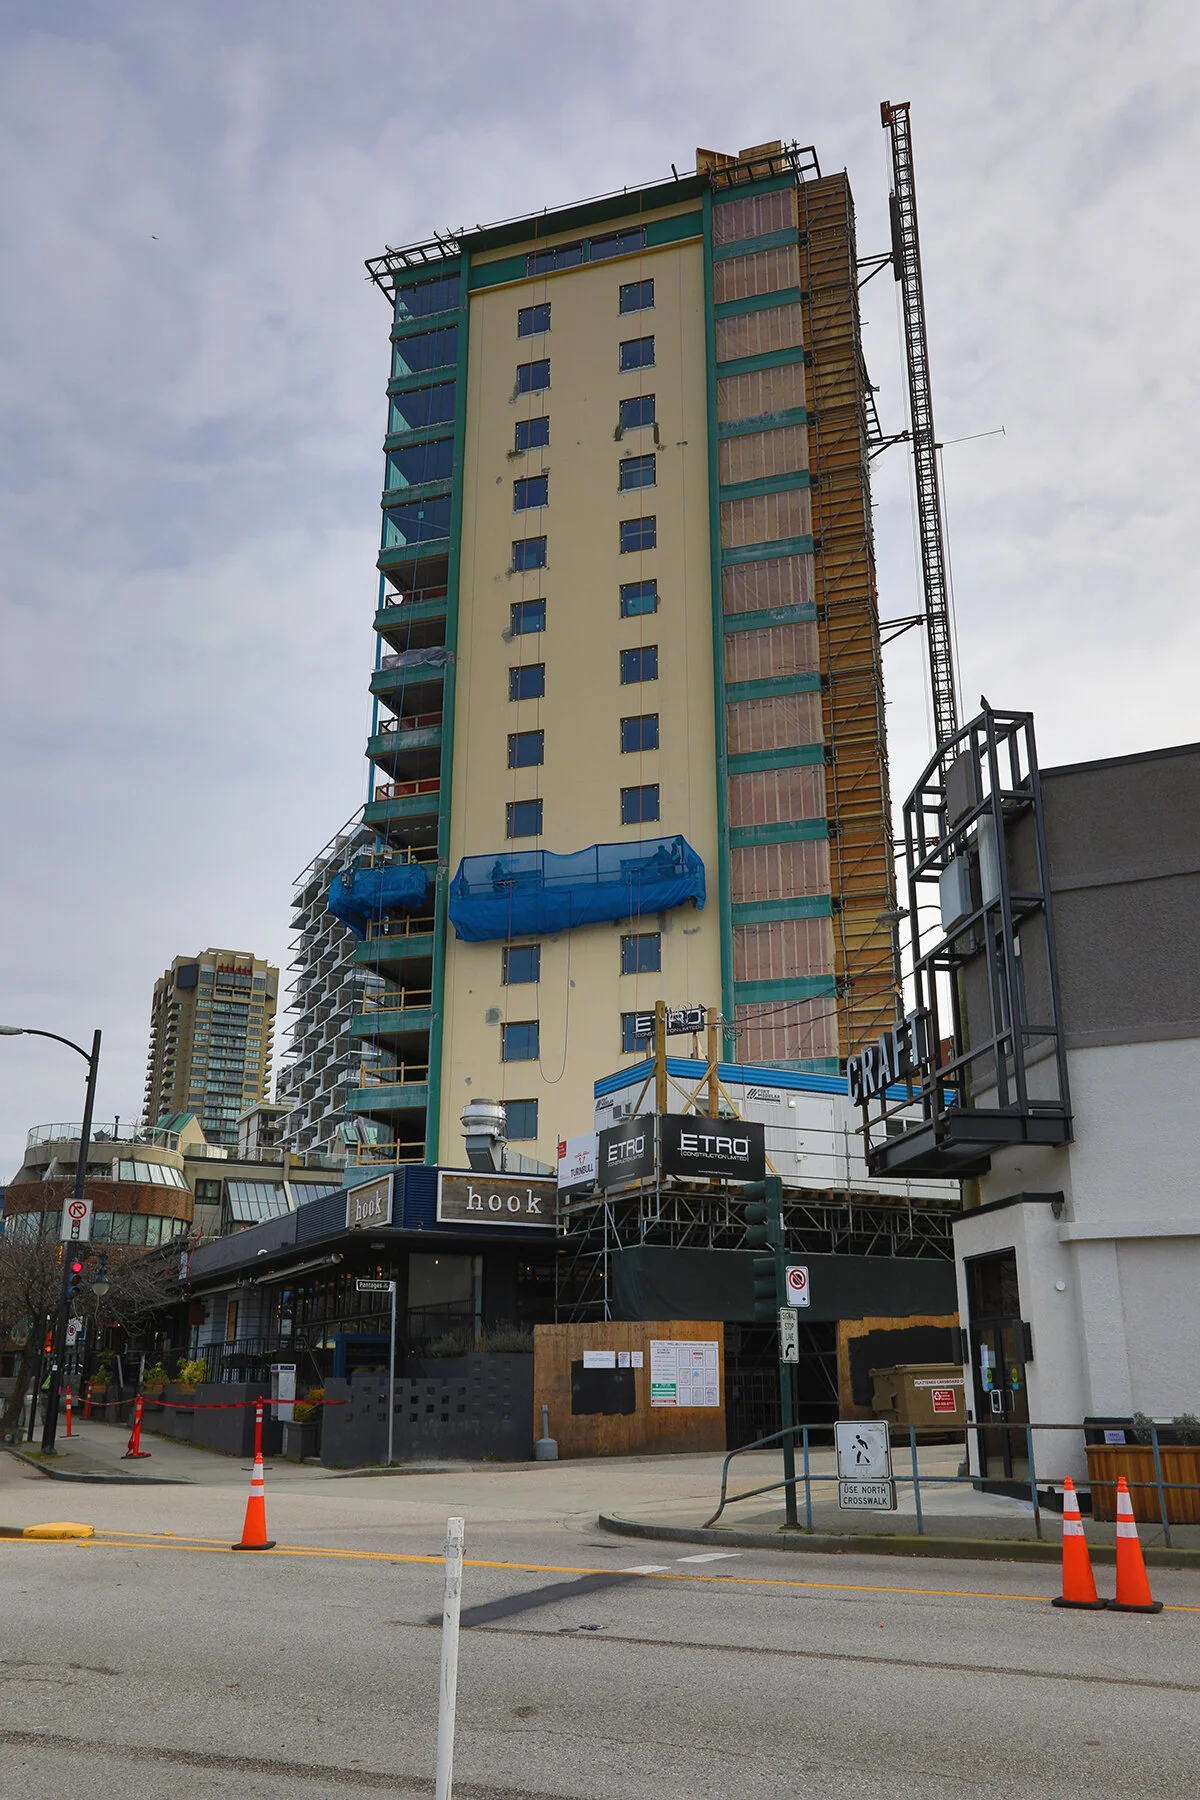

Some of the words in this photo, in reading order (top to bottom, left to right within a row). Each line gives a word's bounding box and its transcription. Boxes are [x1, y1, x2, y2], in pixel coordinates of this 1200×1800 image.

[635, 1009, 702, 1032] ERO
[847, 1009, 922, 1107] CRAFT
[608, 1136, 645, 1162] ETRO
[681, 1133, 749, 1156] ETRO
[683, 1151, 727, 1160] CONSTRUCTION
[571, 1163, 594, 1178] TURNBULL
[355, 1191, 383, 1221] hook
[466, 1186, 542, 1214] hook
[359, 1282, 382, 1290] Pantages
[782, 1312, 796, 1321] SIGNAL
[785, 1322, 795, 1331] STOP
[785, 1332, 794, 1341] LINE
[844, 1486, 858, 1494] USE
[844, 1497, 888, 1505] CROSSWALK
